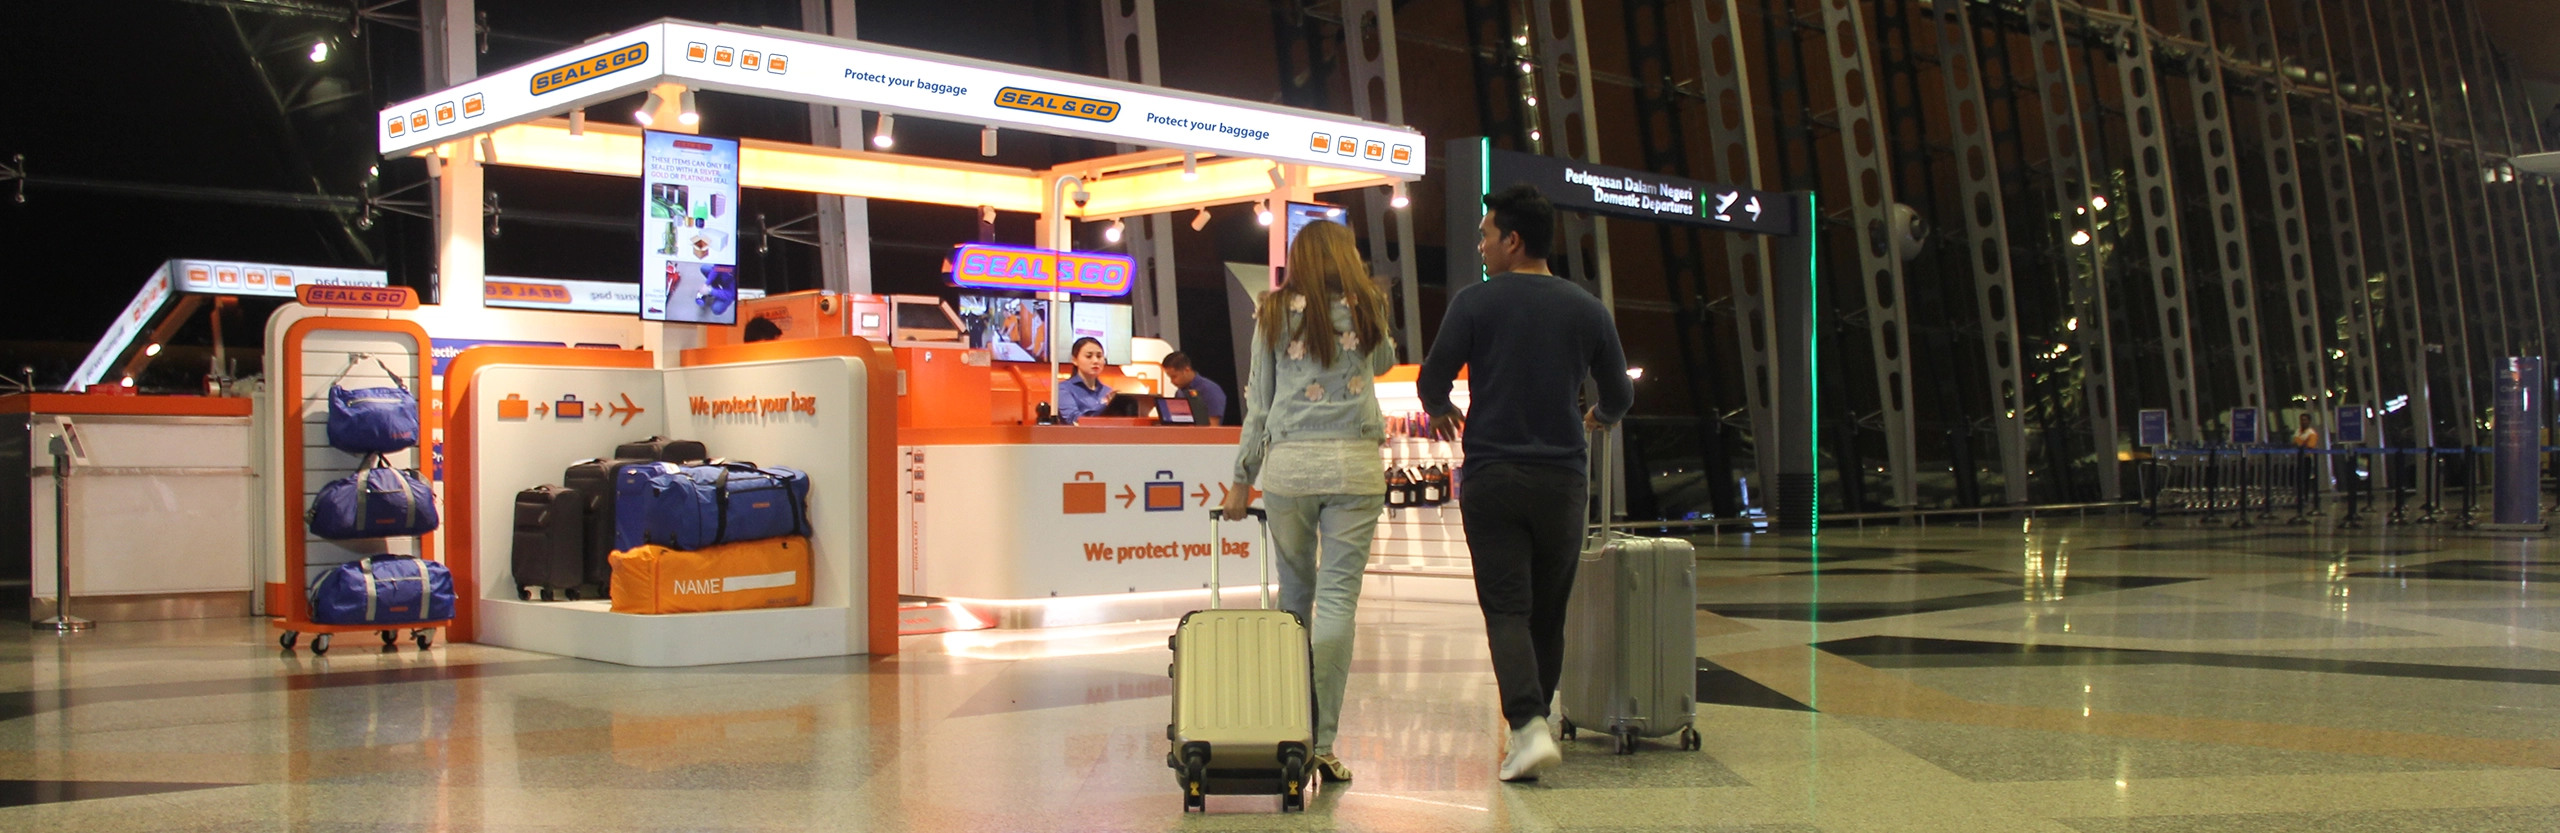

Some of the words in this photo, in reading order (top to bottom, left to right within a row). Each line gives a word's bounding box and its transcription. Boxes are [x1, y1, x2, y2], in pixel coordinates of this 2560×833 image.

[536, 65, 590, 89] SEAL
[595, 59, 608, 72] &
[612, 48, 642, 66] GO
[844, 68, 886, 83] Protect
[888, 76, 914, 87] your
[917, 78, 967, 96] baggage
[1002, 92, 1057, 109] SEAL
[1062, 100, 1076, 112] &
[1080, 104, 1112, 116] GO
[1147, 112, 1188, 127] Protect
[1190, 121, 1216, 131] your
[1219, 123, 1270, 140] baggage
[652, 156, 671, 164] THESE
[672, 158, 690, 166] ITEMS
[680, 174, 712, 182] PLATINUM
[1565, 168, 1622, 190] Perlepasan
[1624, 177, 1657, 195] Dalam
[1660, 183, 1693, 202] Negeri
[1594, 188, 1640, 208] Domestic
[1642, 196, 1693, 214] Departures
[964, 254, 1049, 280] SEAL
[1079, 263, 1126, 285] GO
[312, 290, 358, 301] SEAL
[361, 292, 373, 301] &
[376, 292, 401, 302] GO
[689, 396, 710, 416] We
[712, 396, 757, 418] protect
[760, 398, 789, 417] your
[792, 391, 816, 416] bag
[1084, 542, 1113, 562] We
[1118, 541, 1178, 564] protect
[1182, 543, 1212, 561] you
[1222, 538, 1250, 558] bag
[674, 578, 720, 594] NAME
